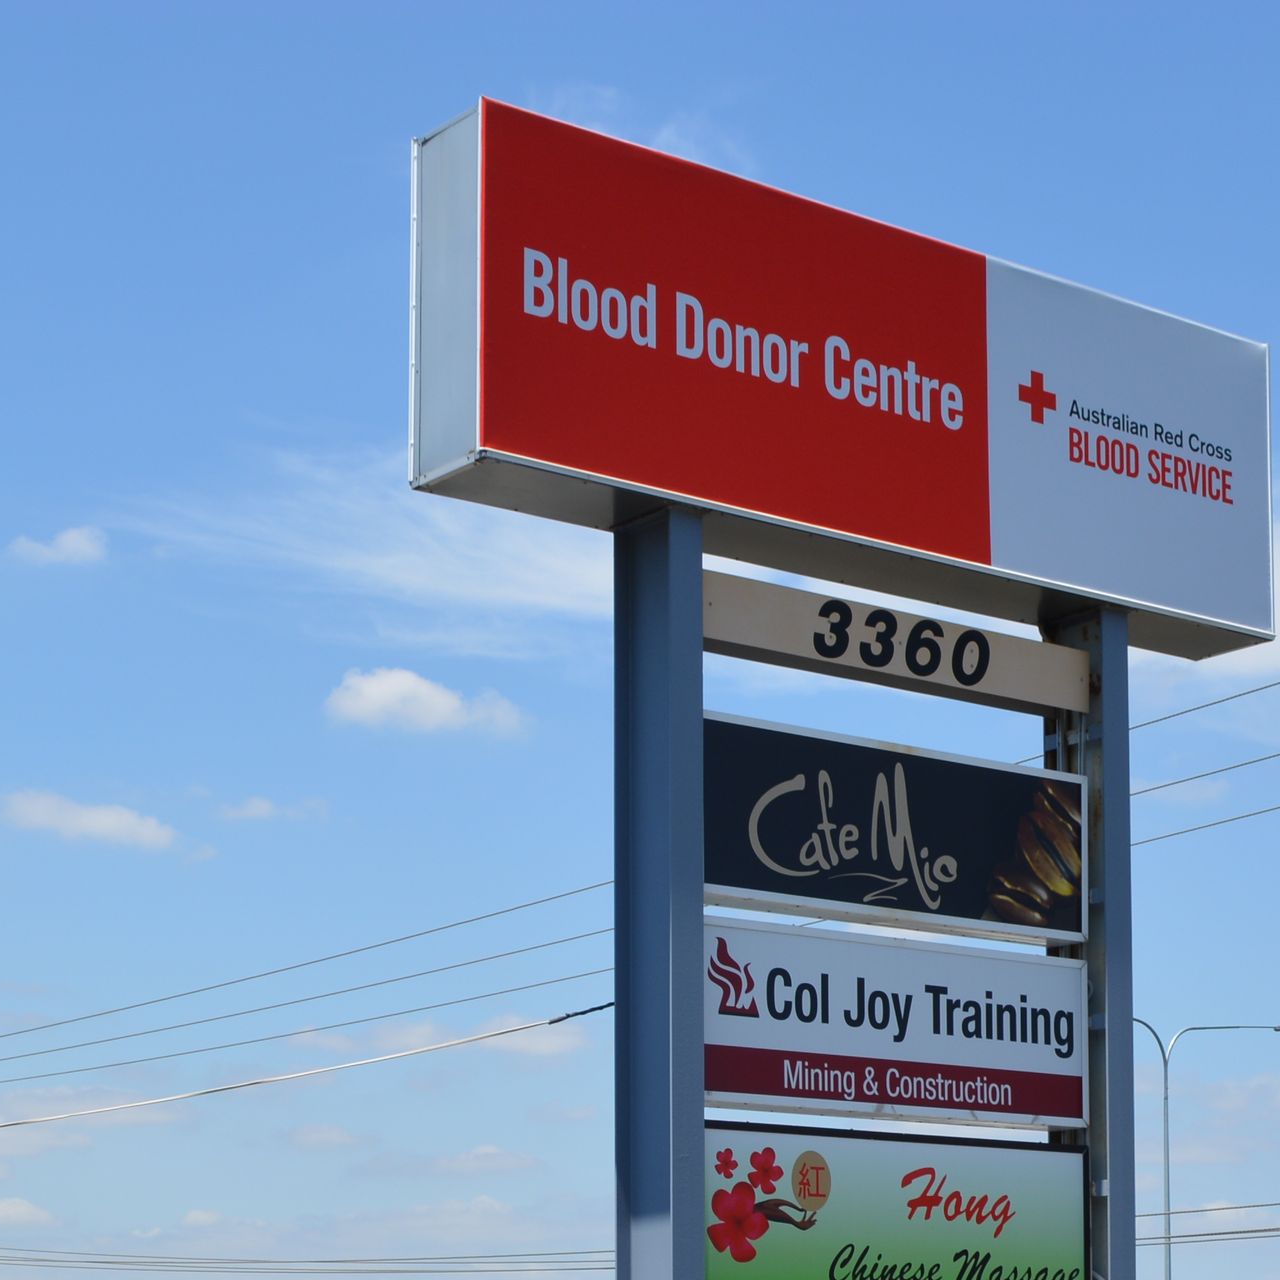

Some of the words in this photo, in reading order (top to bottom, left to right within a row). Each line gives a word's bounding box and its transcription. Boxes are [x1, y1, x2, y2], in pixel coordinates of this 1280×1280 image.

[523, 246, 657, 349] Blood
[676, 291, 809, 388] Donor
[824, 335, 964, 431] Centre
[1069, 399, 1148, 438] Australian
[1154, 423, 1184, 448] Red
[1188, 433, 1233, 462] Cross
[1069, 427, 1140, 478] BLOOD
[1147, 449, 1234, 505] SERVICE
[813, 600, 990, 686] 3360
[871, 762, 958, 910] Mio
[766, 967, 830, 1024] Col
[844, 977, 913, 1043] Joy
[924, 984, 1074, 1059] Training
[783, 1059, 856, 1100] Mining
[862, 1067, 879, 1096] &
[886, 1068, 1012, 1106] Construction
[901, 1167, 1016, 1238] Hong
